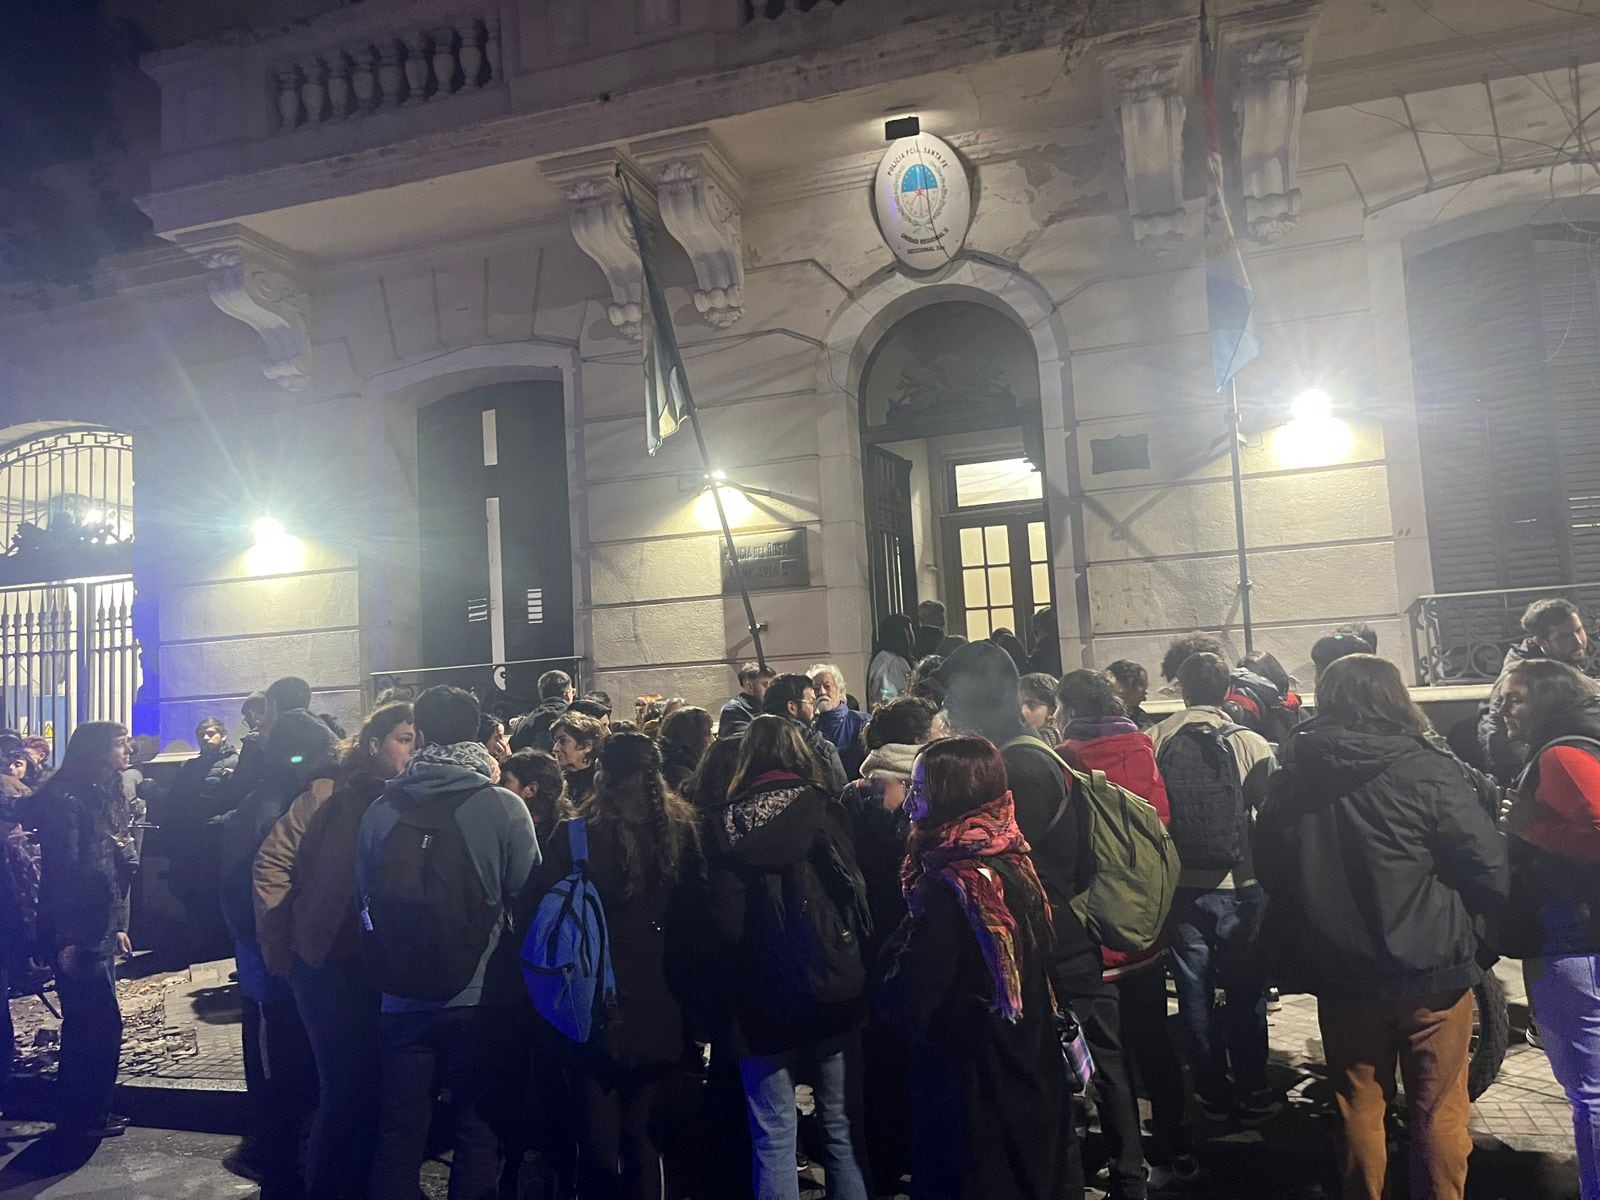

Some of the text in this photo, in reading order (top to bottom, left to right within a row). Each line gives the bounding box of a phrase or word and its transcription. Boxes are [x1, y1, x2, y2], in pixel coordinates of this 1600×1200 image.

[887, 153, 905, 176] POLICIA
[923, 147, 942, 160] SANTA
[940, 160, 949, 168] FE
[754, 545, 767, 558] DEL
